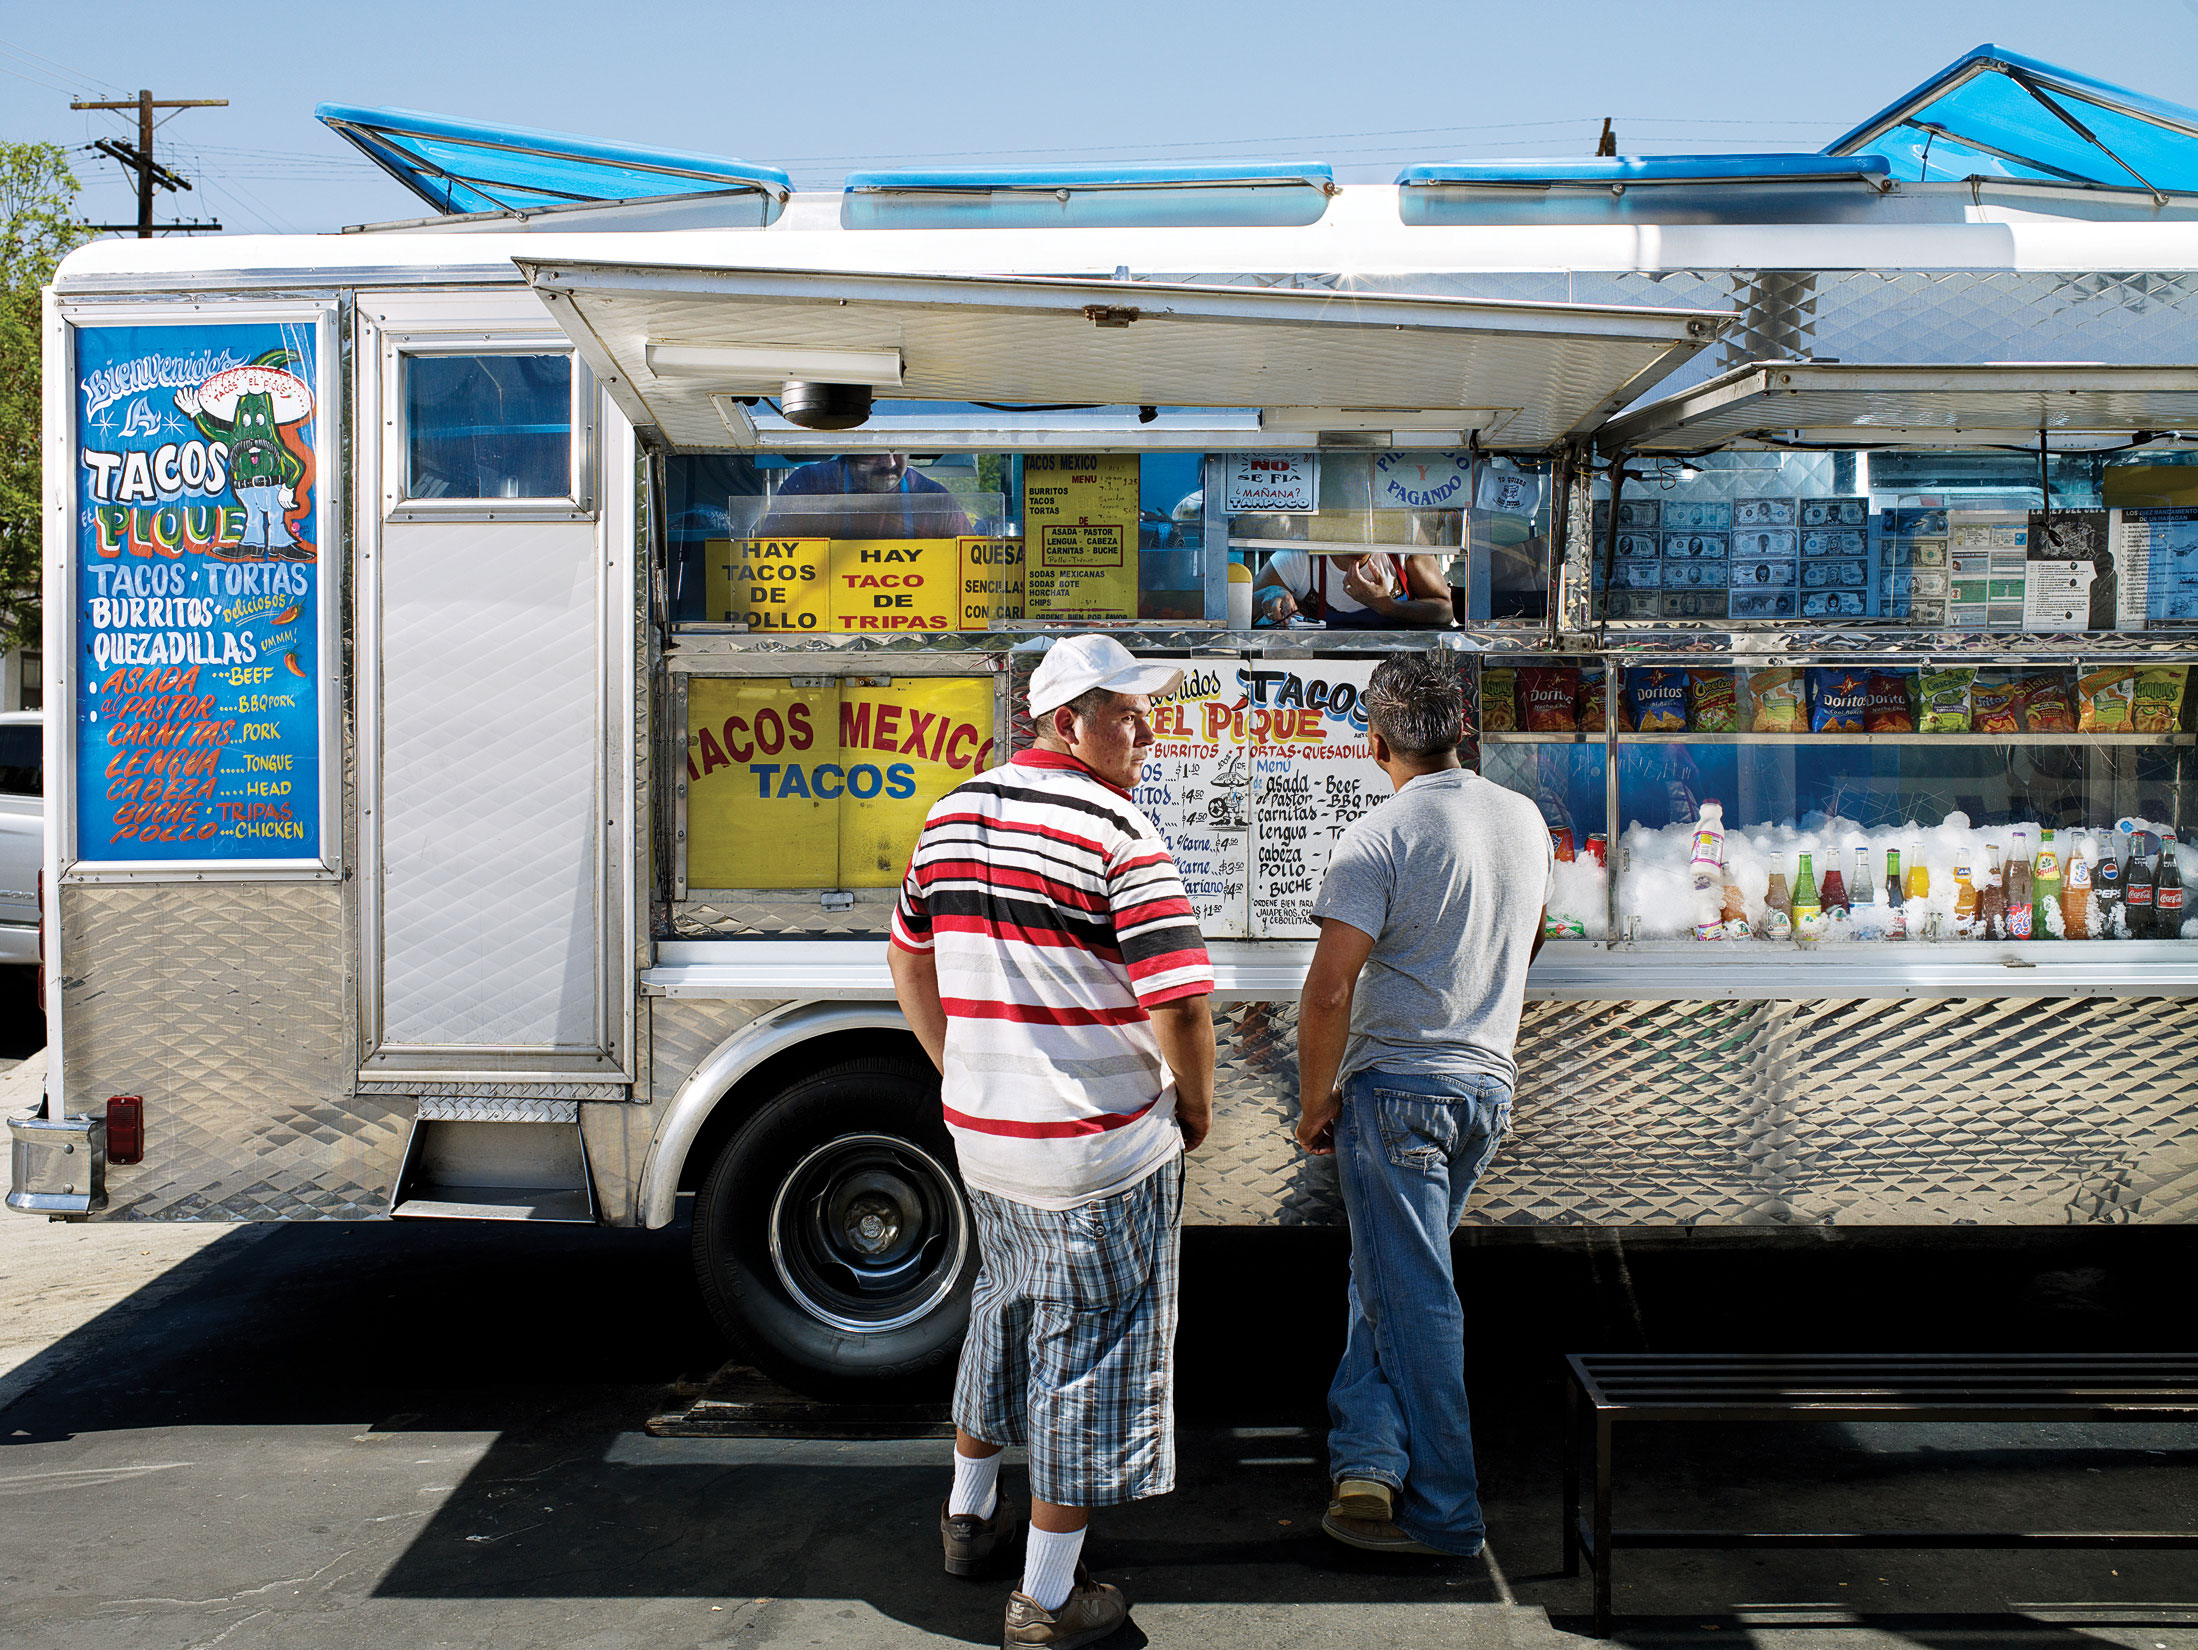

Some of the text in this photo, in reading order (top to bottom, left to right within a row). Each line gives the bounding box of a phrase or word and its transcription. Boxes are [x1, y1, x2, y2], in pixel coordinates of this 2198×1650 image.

[249, 377, 259, 386] EL
[118, 395, 162, 437] A
[1025, 455, 1055, 471] TACOS
[1060, 455, 1097, 471] MEXICO
[1251, 460, 1290, 471] NO
[83, 440, 230, 504] TACOS
[1072, 475, 1097, 484] MENU
[1238, 474, 1302, 484] SE FIA
[1416, 465, 1430, 480] Y
[1387, 475, 1461, 505] PAGANDO
[1029, 507, 1060, 515] TORTAS
[1230, 498, 1309, 509] TAMPOCO
[1079, 516, 1089, 525] DE
[95, 505, 247, 556] PIQUE
[743, 542, 799, 559] HAY
[860, 549, 924, 563] HAY
[1047, 547, 1084, 555] CARNITAS
[87, 563, 308, 597] TACOS TORTAS
[722, 565, 816, 581] TACOS
[842, 575, 925, 588] TACO
[750, 587, 787, 603] DE
[874, 594, 914, 608] DE
[1029, 599, 1052, 607] CHIPS
[89, 597, 214, 628] BURRITOS
[965, 605, 989, 619] CON
[724, 612, 817, 629] POLLO
[838, 615, 948, 629] TRIPAS
[93, 631, 257, 671] QUEZADILLAS
[101, 665, 200, 694] ASADA
[1637, 686, 1683, 701] Doritos
[1823, 694, 1865, 708] Dorito
[1866, 693, 1906, 706] Dorito
[118, 694, 216, 720] PASTOR
[1152, 704, 1194, 737] EL
[107, 720, 236, 747] CARNITAS
[1154, 742, 1219, 760] BURRITOS
[105, 748, 221, 780] LENGUA
[107, 777, 218, 801] CABEZA
[750, 763, 916, 799] TACOS
[113, 801, 293, 826] BUCHE TRIPAS
[1259, 823, 1308, 847] lengua
[1259, 843, 1302, 863] cabeza
[2035, 864, 2058, 878] Squirt
[1270, 877, 1314, 898] BUCHE
[2094, 888, 2121, 899] PEPS
